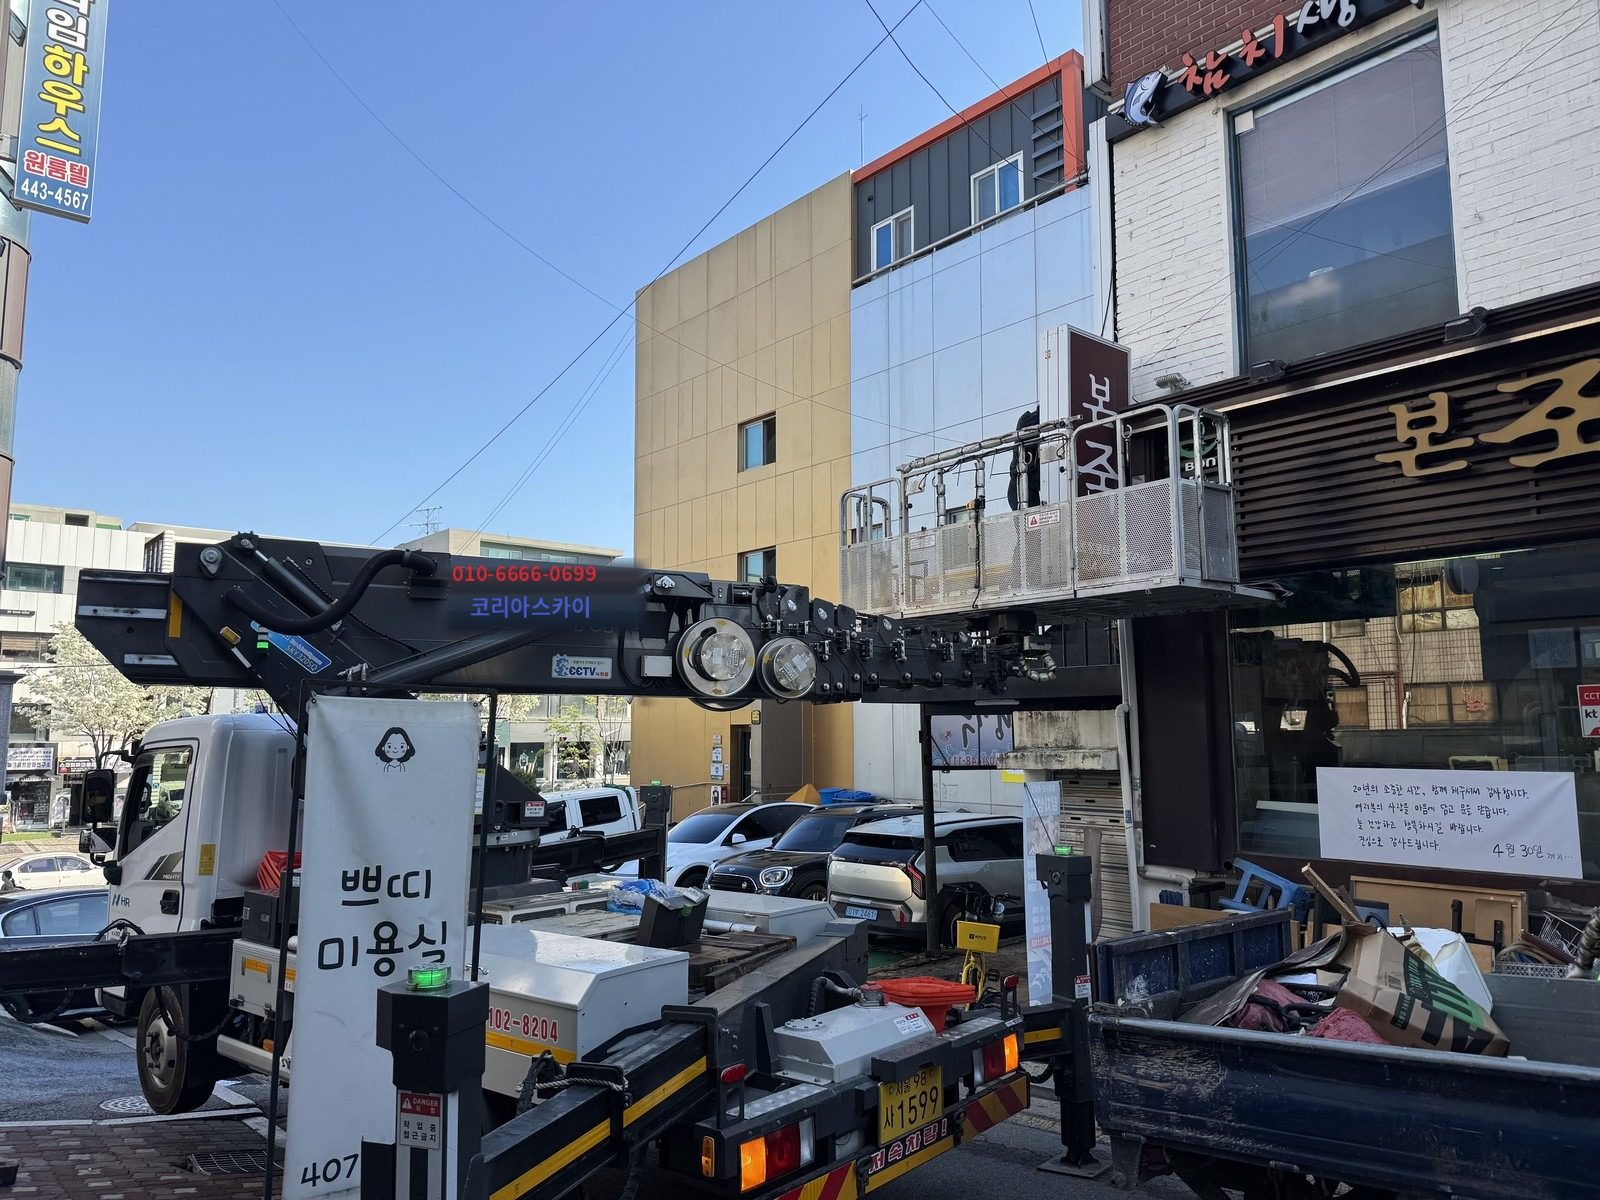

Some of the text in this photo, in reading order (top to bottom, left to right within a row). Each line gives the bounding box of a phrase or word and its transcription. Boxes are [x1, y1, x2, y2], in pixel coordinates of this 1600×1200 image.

[24, 150, 90, 188] 원룸텔
[21, 178, 89, 210] 443-4567
[569, 666, 596, 676] CCTV
[1584, 709, 1598, 719] kt
[1353, 783, 1378, 796] 20년의
[1384, 783, 1403, 796] 소중한
[1432, 785, 1448, 796] 함께
[1355, 803, 1383, 813] 여러분의
[1388, 802, 1409, 815] 사랑을
[1414, 803, 1435, 815] 마음에
[1440, 804, 1455, 816] 담고
[1477, 805, 1510, 819] 닫습니다.
[1357, 818, 1484, 835] 늘 건강하고 행복하시길 바랍니다.
[1359, 836, 1441, 852] 진심으로 감사드립니다.
[341, 864, 432, 907] 쁘띠
[120, 895, 131, 907] HR
[412, 1097, 440, 1107] DANGER
[403, 1130, 437, 1143] 접근금지
[300, 1153, 359, 1187] 407
